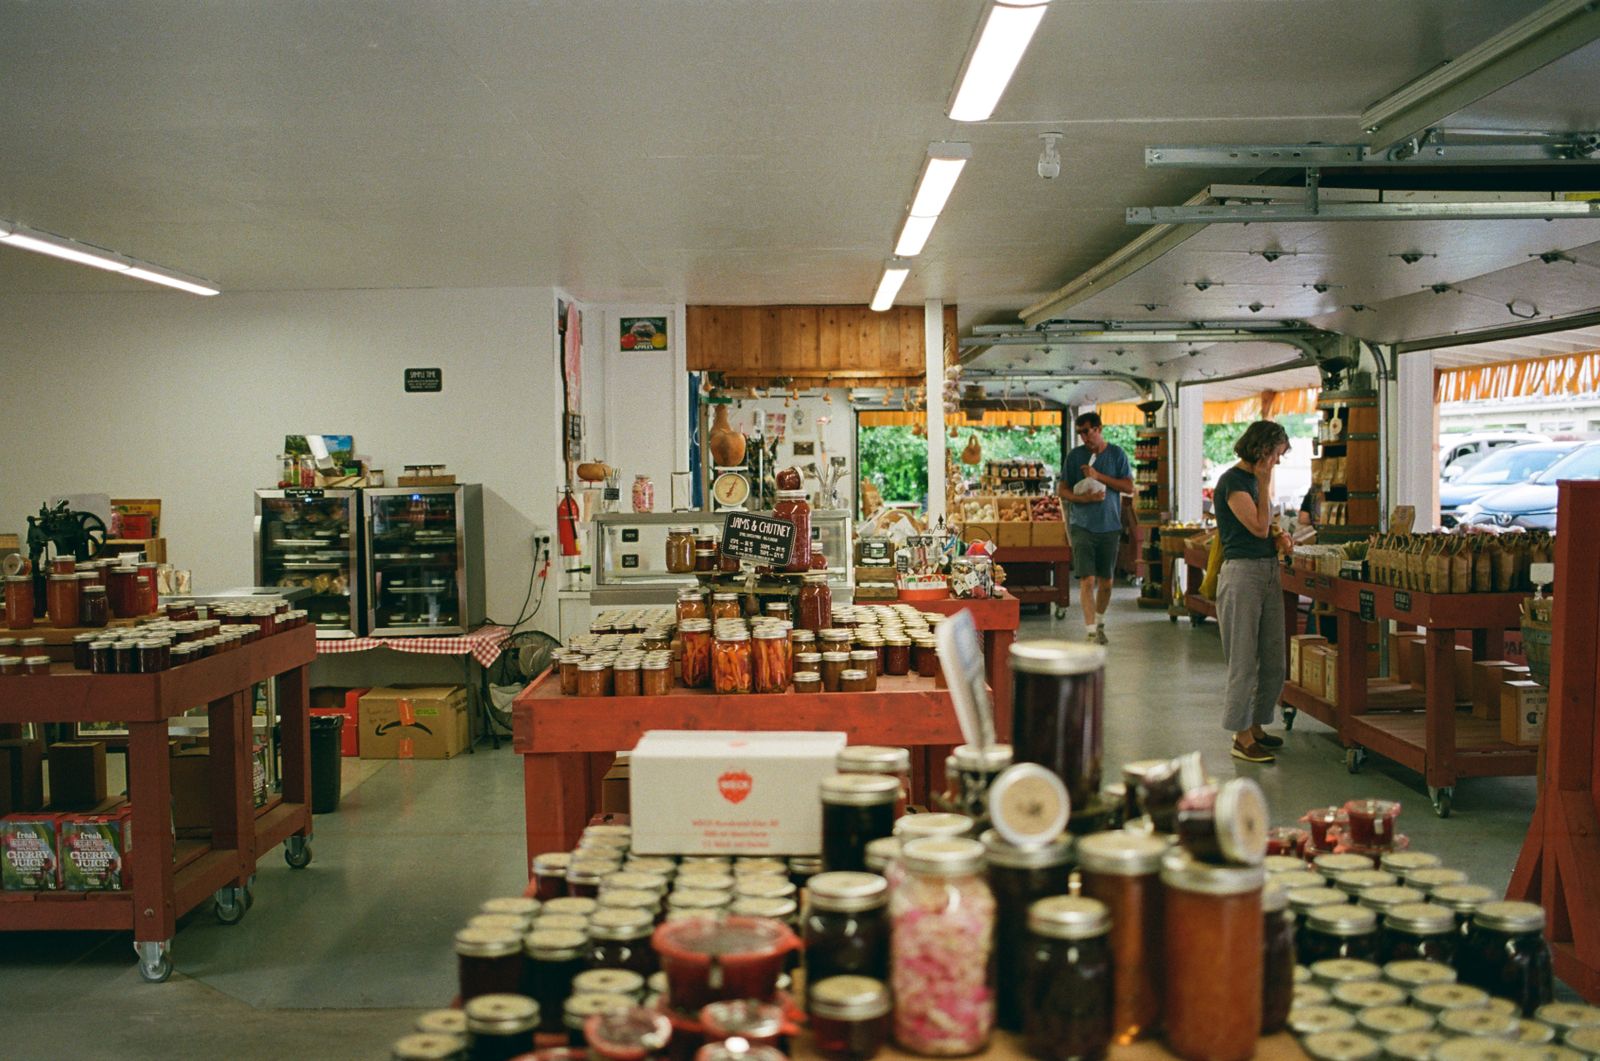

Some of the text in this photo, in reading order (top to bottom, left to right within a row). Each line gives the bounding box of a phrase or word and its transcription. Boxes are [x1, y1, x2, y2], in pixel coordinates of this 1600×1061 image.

[730, 517, 751, 531] JAMS
[751, 520, 757, 532] &
[759, 521, 791, 538] CHUTNEY
[16, 831, 38, 839] fresh
[80, 831, 102, 840] fresh
[6, 850, 49, 859] CHERRY
[70, 851, 114, 860] CHERRY
[11, 858, 45, 867] JUICE
[75, 859, 110, 868] JUICE
